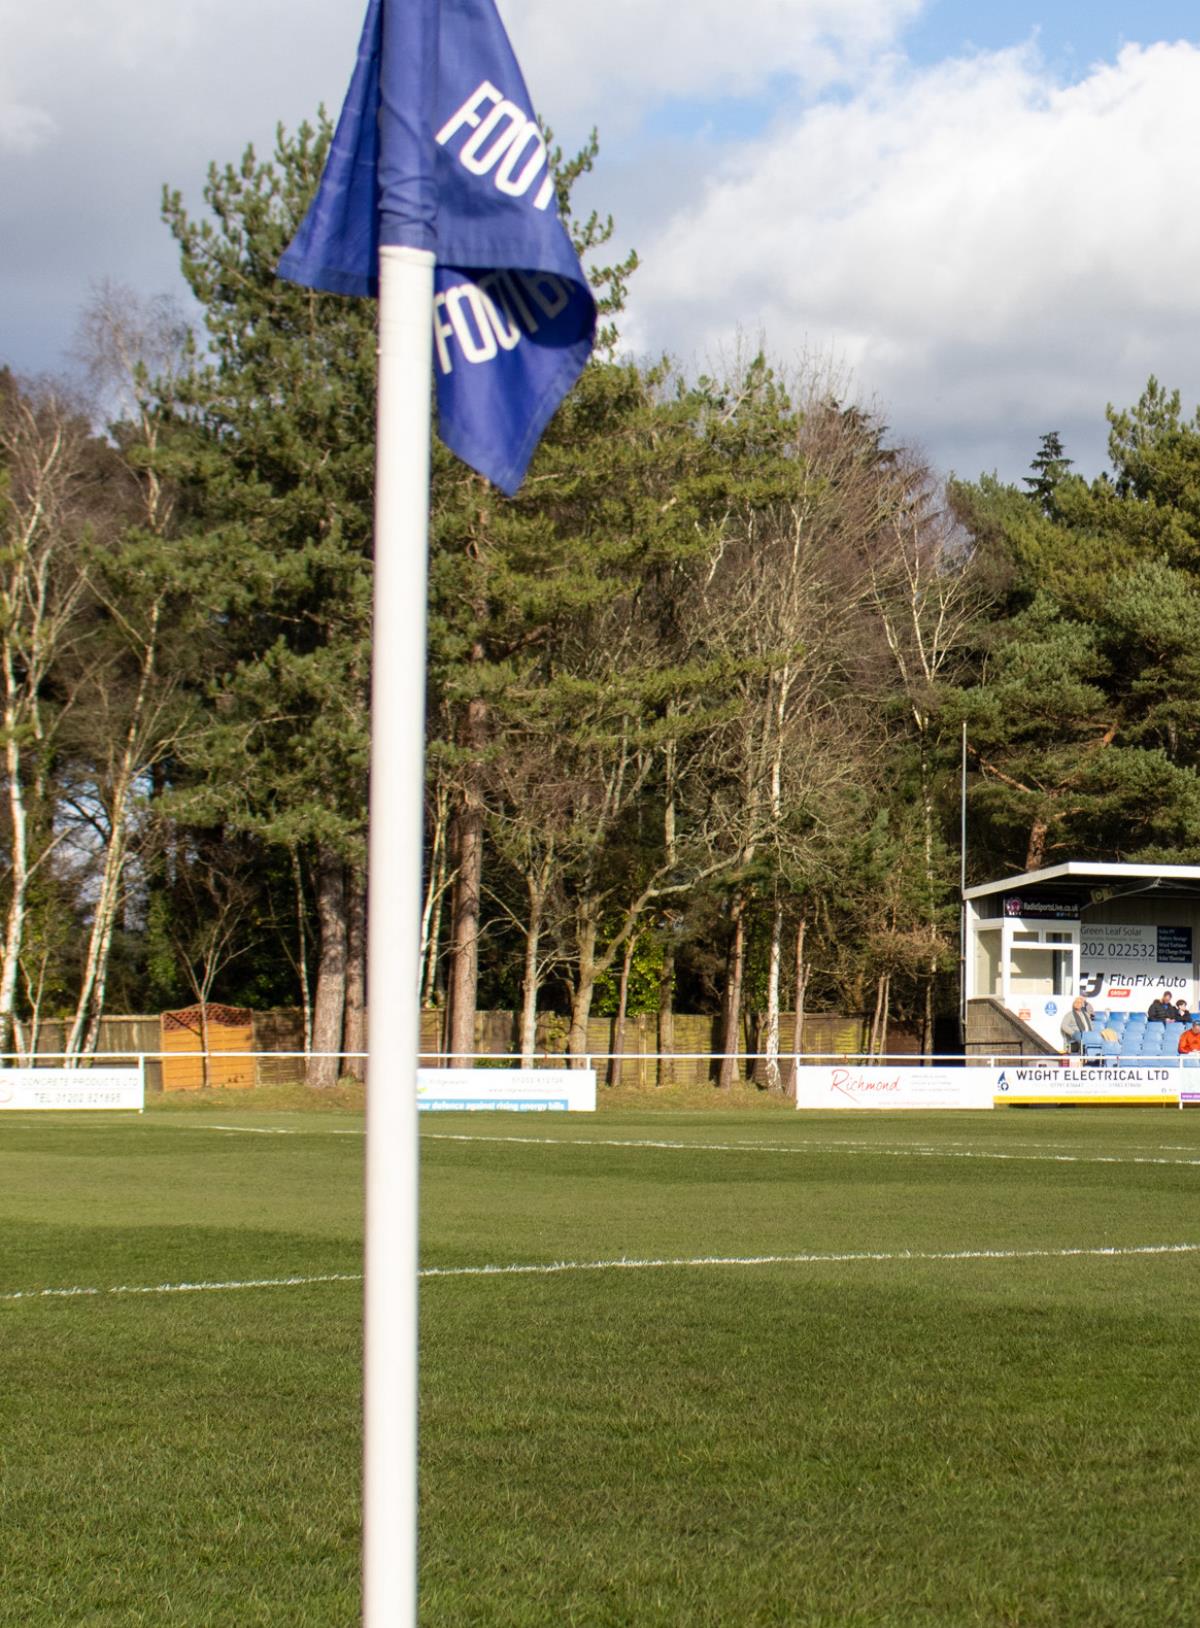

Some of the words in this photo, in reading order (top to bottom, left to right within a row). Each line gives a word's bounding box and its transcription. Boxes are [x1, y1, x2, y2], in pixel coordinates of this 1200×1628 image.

[1080, 926, 1104, 936] Green
[1105, 926, 1122, 936] Leaf
[1122, 927, 1142, 936] Solar
[1081, 942, 1105, 956] 202
[1108, 943, 1155, 957] 022532
[1109, 973, 1153, 987] FitnFix
[1156, 975, 1187, 988] Auto
[1016, 1069, 1059, 1081] WIGHT
[1064, 1069, 1143, 1081] ELECTRICAL
[1148, 1069, 1169, 1081] LTD
[830, 1069, 901, 1104] Richmond
